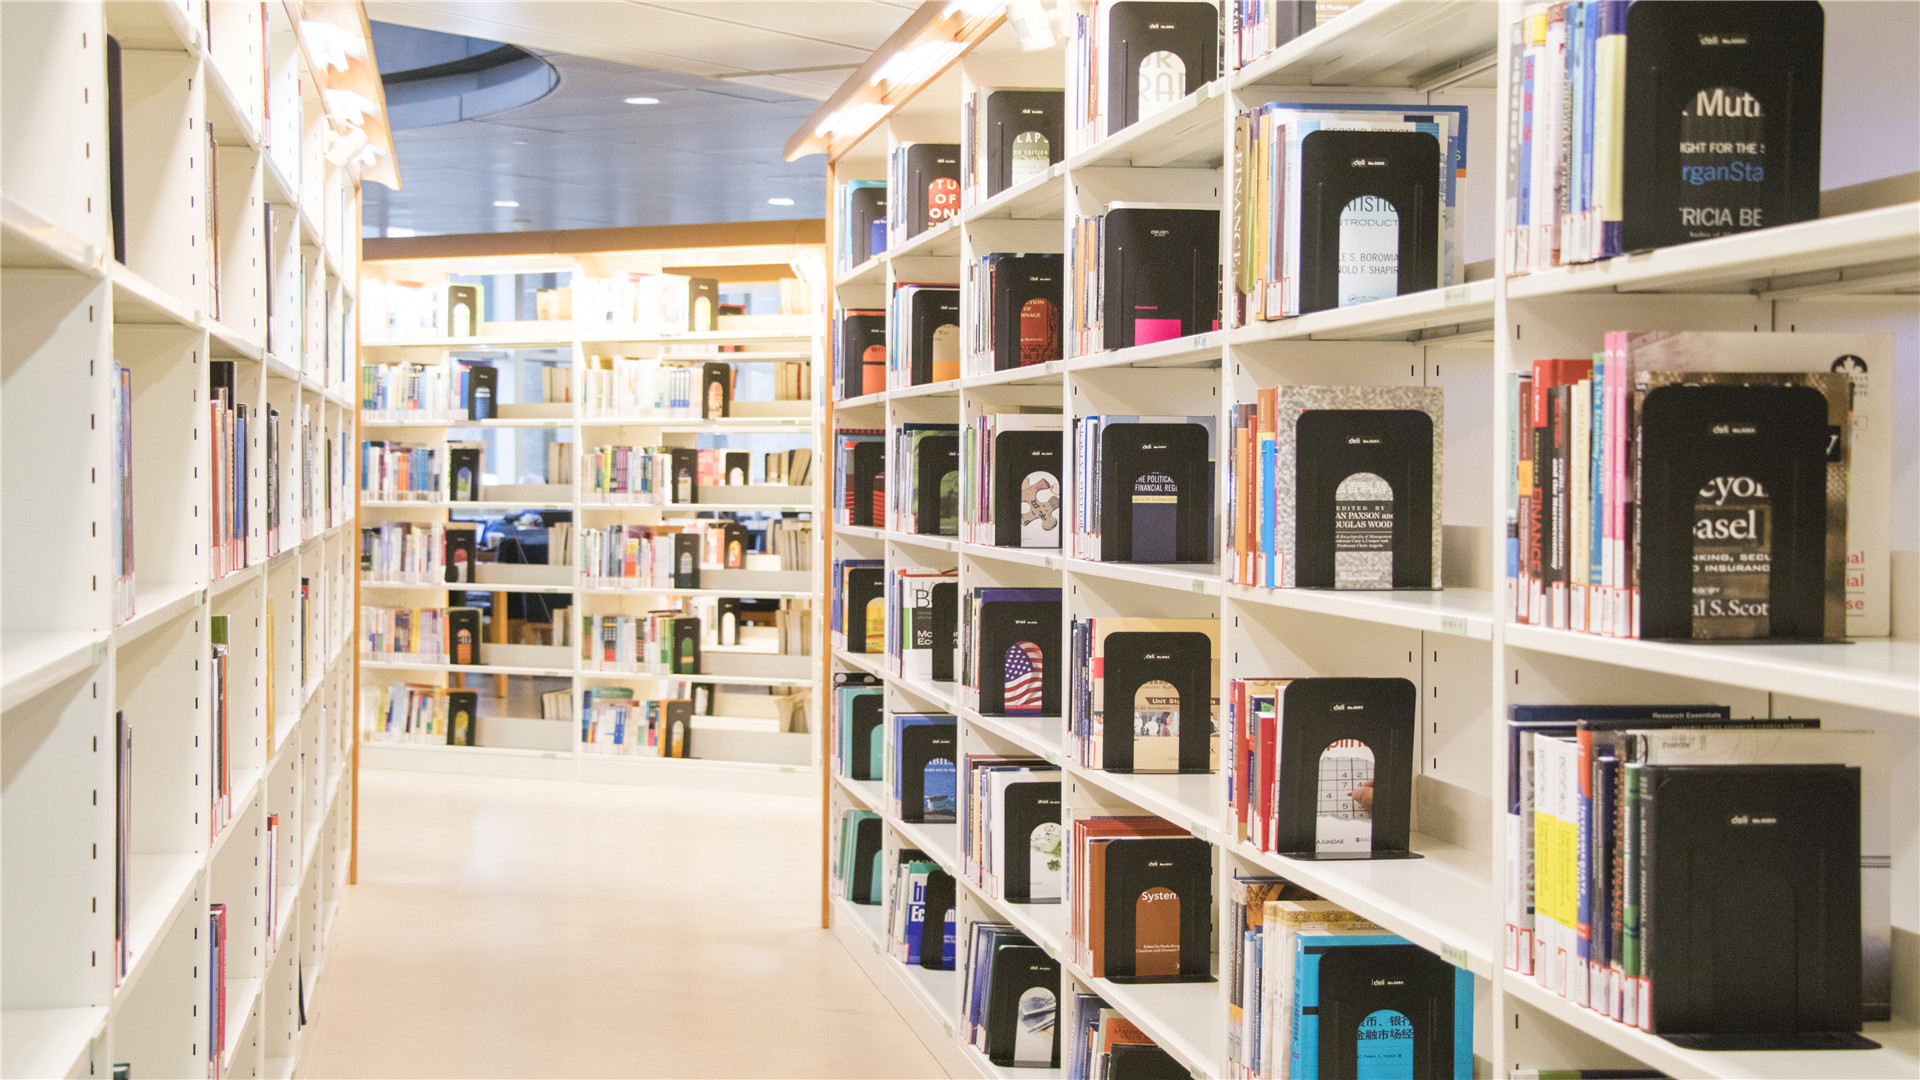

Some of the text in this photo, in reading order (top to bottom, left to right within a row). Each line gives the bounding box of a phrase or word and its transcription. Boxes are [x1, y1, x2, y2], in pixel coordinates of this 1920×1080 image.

[1710, 142, 1733, 154] FOR
[1736, 142, 1758, 154] THE
[935, 194, 958, 205] OF
[1232, 151, 1243, 264] FINANCE
[1135, 484, 1163, 492] FINANCIAL
[1348, 512, 1380, 520] PAXSON
[1531, 488, 1543, 572] FINANCE
[1710, 599, 1727, 617] S.
